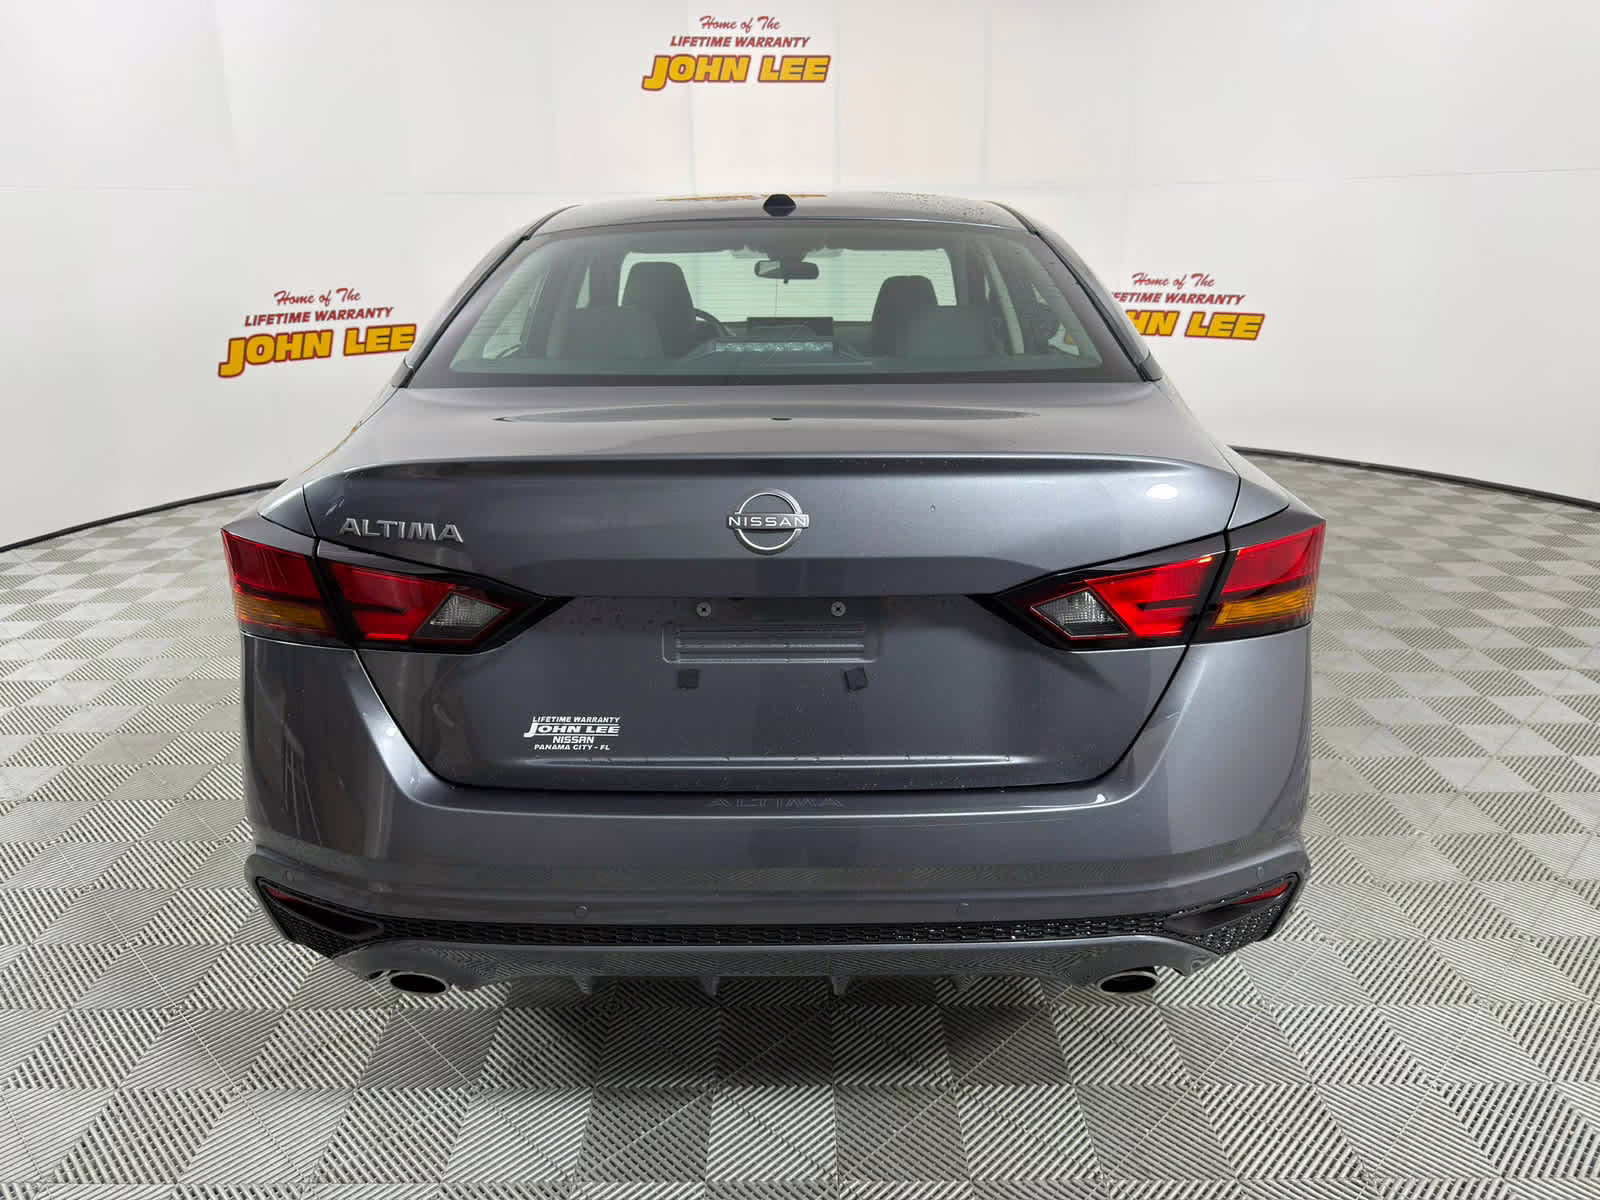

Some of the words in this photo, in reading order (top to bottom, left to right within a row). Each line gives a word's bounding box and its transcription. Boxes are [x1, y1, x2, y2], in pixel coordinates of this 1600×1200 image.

[699, 15, 737, 30] Home
[740, 18, 753, 33] of
[757, 16, 781, 30] The
[670, 35, 731, 47] LIFETIME
[735, 36, 810, 48] WARRANTY
[641, 54, 751, 91] JOHN
[757, 55, 831, 83] LEE
[1131, 272, 1169, 287] Home
[1172, 274, 1187, 290] of
[1191, 273, 1215, 288] The
[274, 290, 314, 306] Home
[318, 290, 332, 307] of
[336, 287, 360, 302] The
[1165, 293, 1246, 306] WARRANTY
[244, 311, 310, 327] LIFETIME
[315, 306, 394, 322] WARRANTY
[1184, 311, 1266, 341] LEE
[218, 329, 334, 378] JOHN
[343, 323, 417, 356] LEE
[338, 517, 464, 544] ALTIMA
[728, 516, 806, 527] NISSAN
[523, 722, 581, 738] JOHN
[585, 725, 620, 734] LEE
[552, 735, 595, 744] NISSAN
